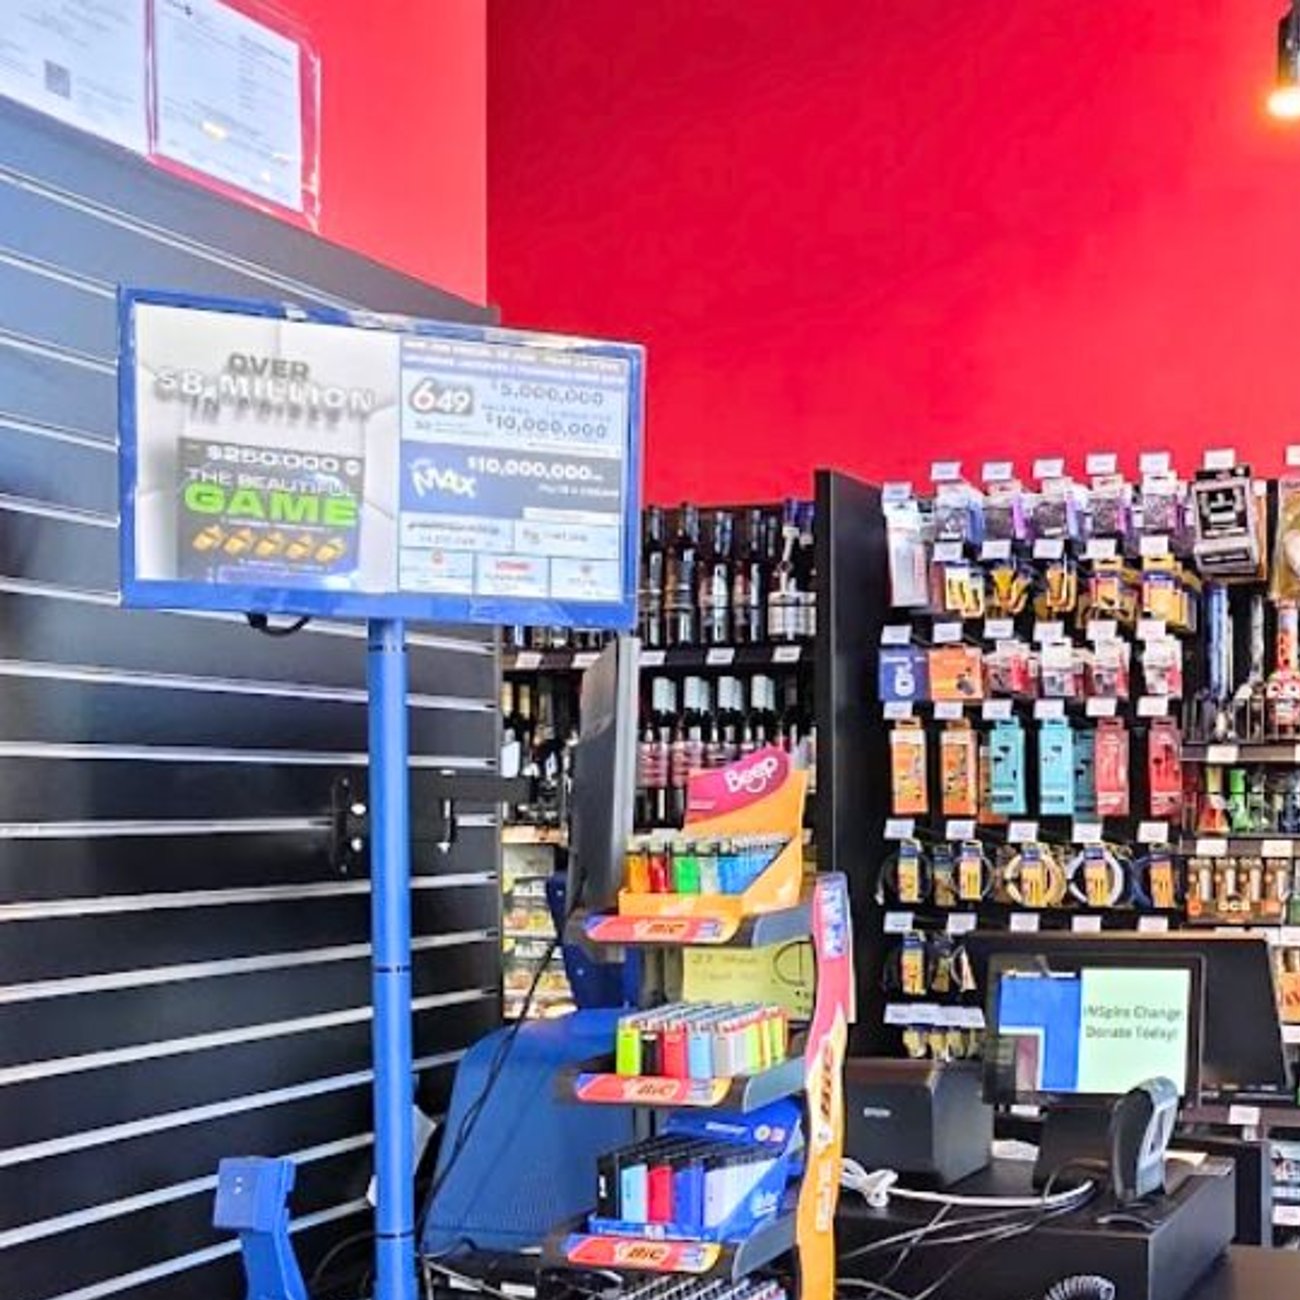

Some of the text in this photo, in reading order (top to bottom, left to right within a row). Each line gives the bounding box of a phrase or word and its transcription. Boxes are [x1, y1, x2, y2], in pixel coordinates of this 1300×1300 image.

[228, 352, 310, 381] OVER
[219, 375, 376, 412] MILLION
[184, 481, 358, 526] GAME
